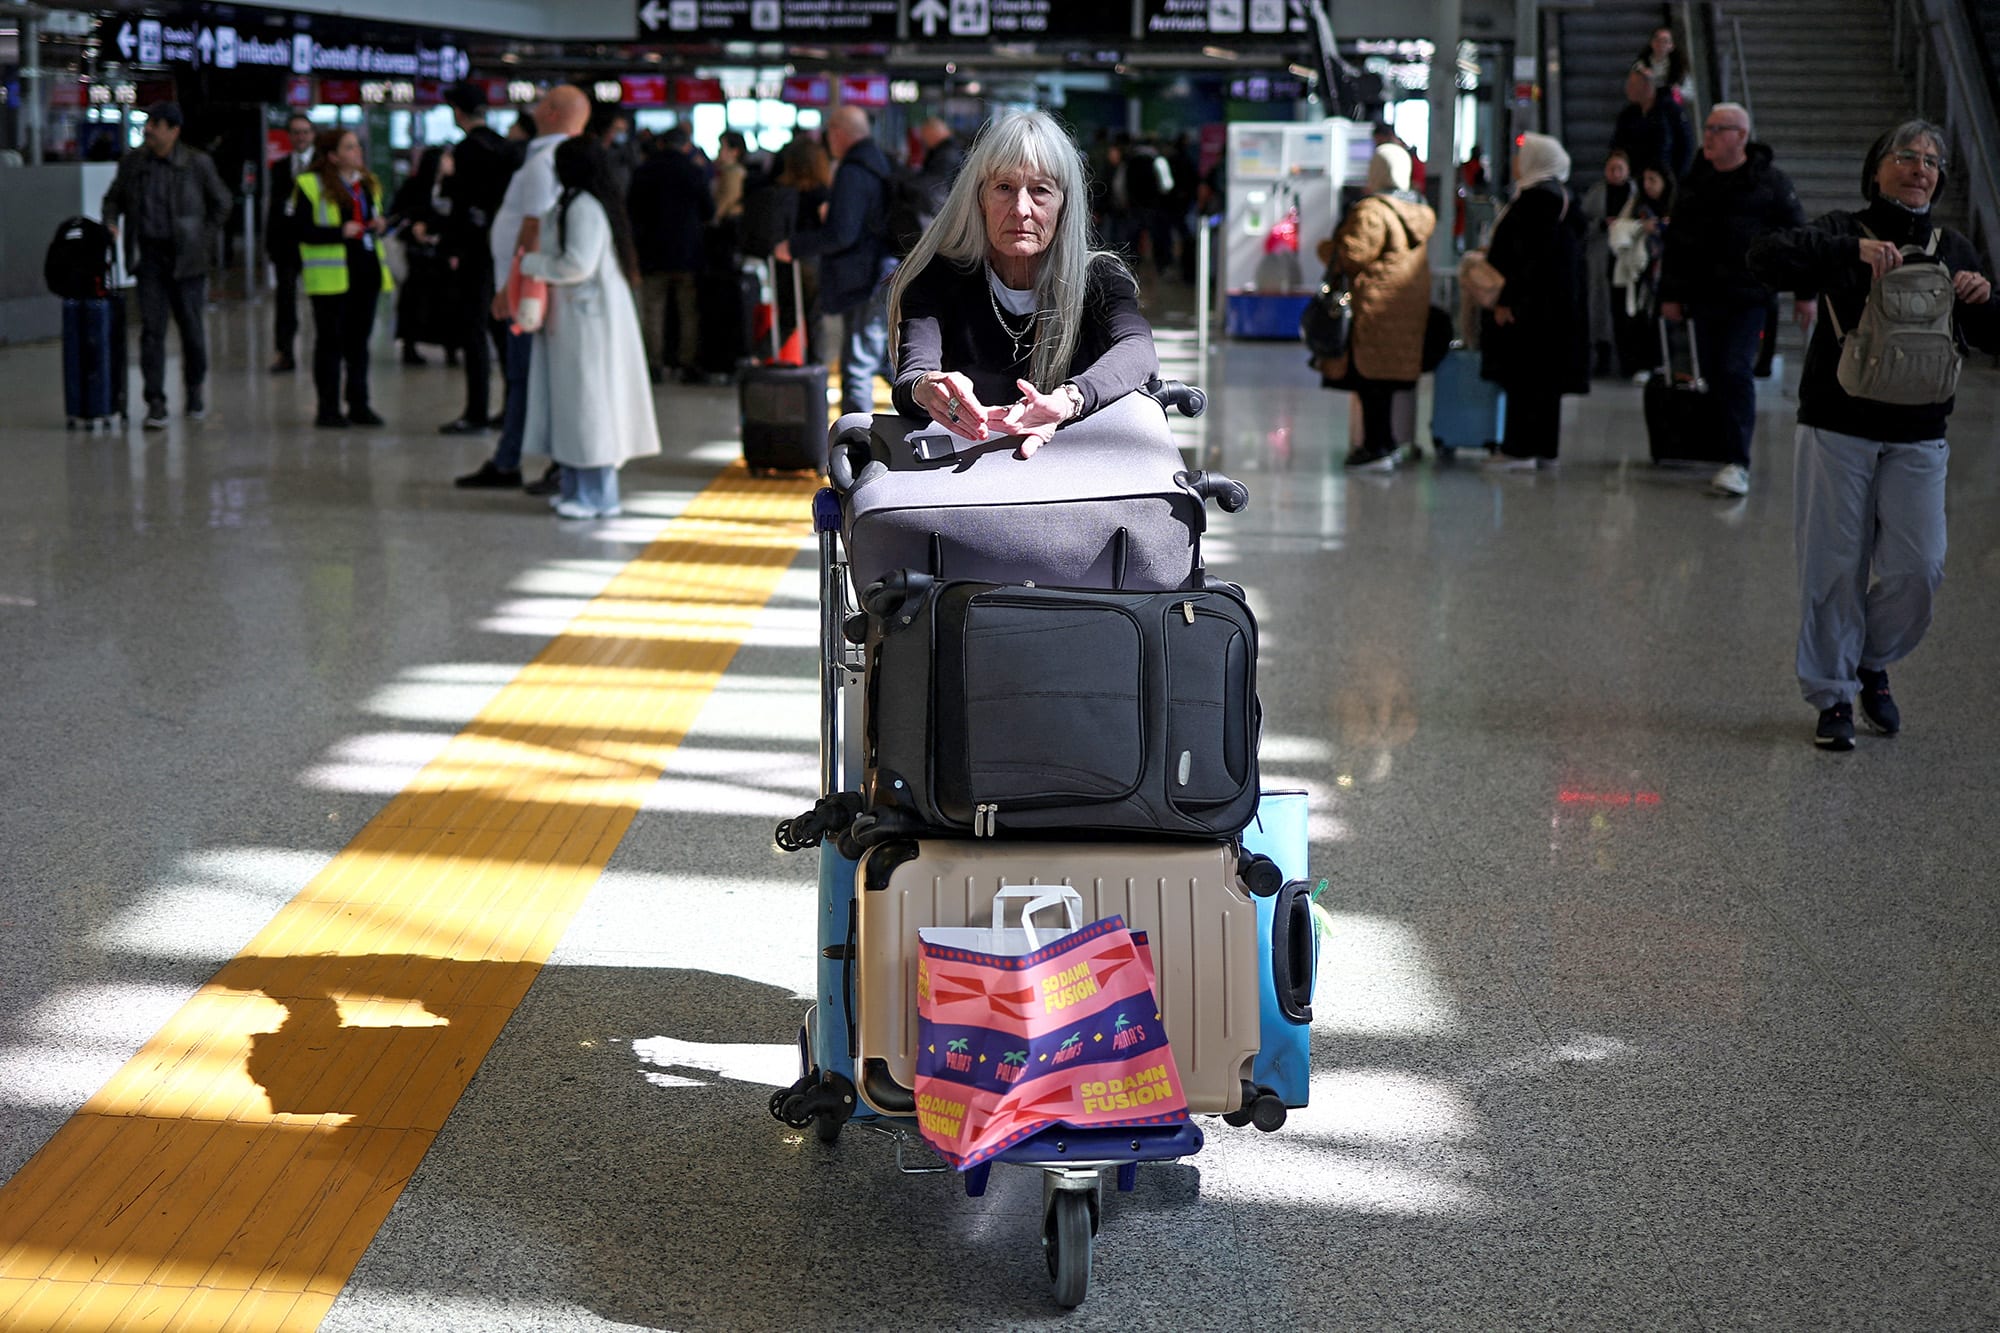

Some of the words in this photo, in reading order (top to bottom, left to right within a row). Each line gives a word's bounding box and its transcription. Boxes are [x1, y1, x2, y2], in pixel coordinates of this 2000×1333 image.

[1149, 14, 1206, 32] Arrivals
[236, 35, 291, 66] Imbarchi
[312, 42, 358, 71] Controlli
[359, 46, 371, 72] di
[1041, 975, 1060, 995] SO
[1058, 961, 1090, 987] DAMN
[1044, 977, 1098, 1016] FUSION
[1080, 1081, 1107, 1098] SO
[1108, 1063, 1168, 1093] DAMN
[918, 1094, 932, 1109] SO
[931, 1096, 966, 1120] DAMN
[1082, 1079, 1173, 1115] FUSION
